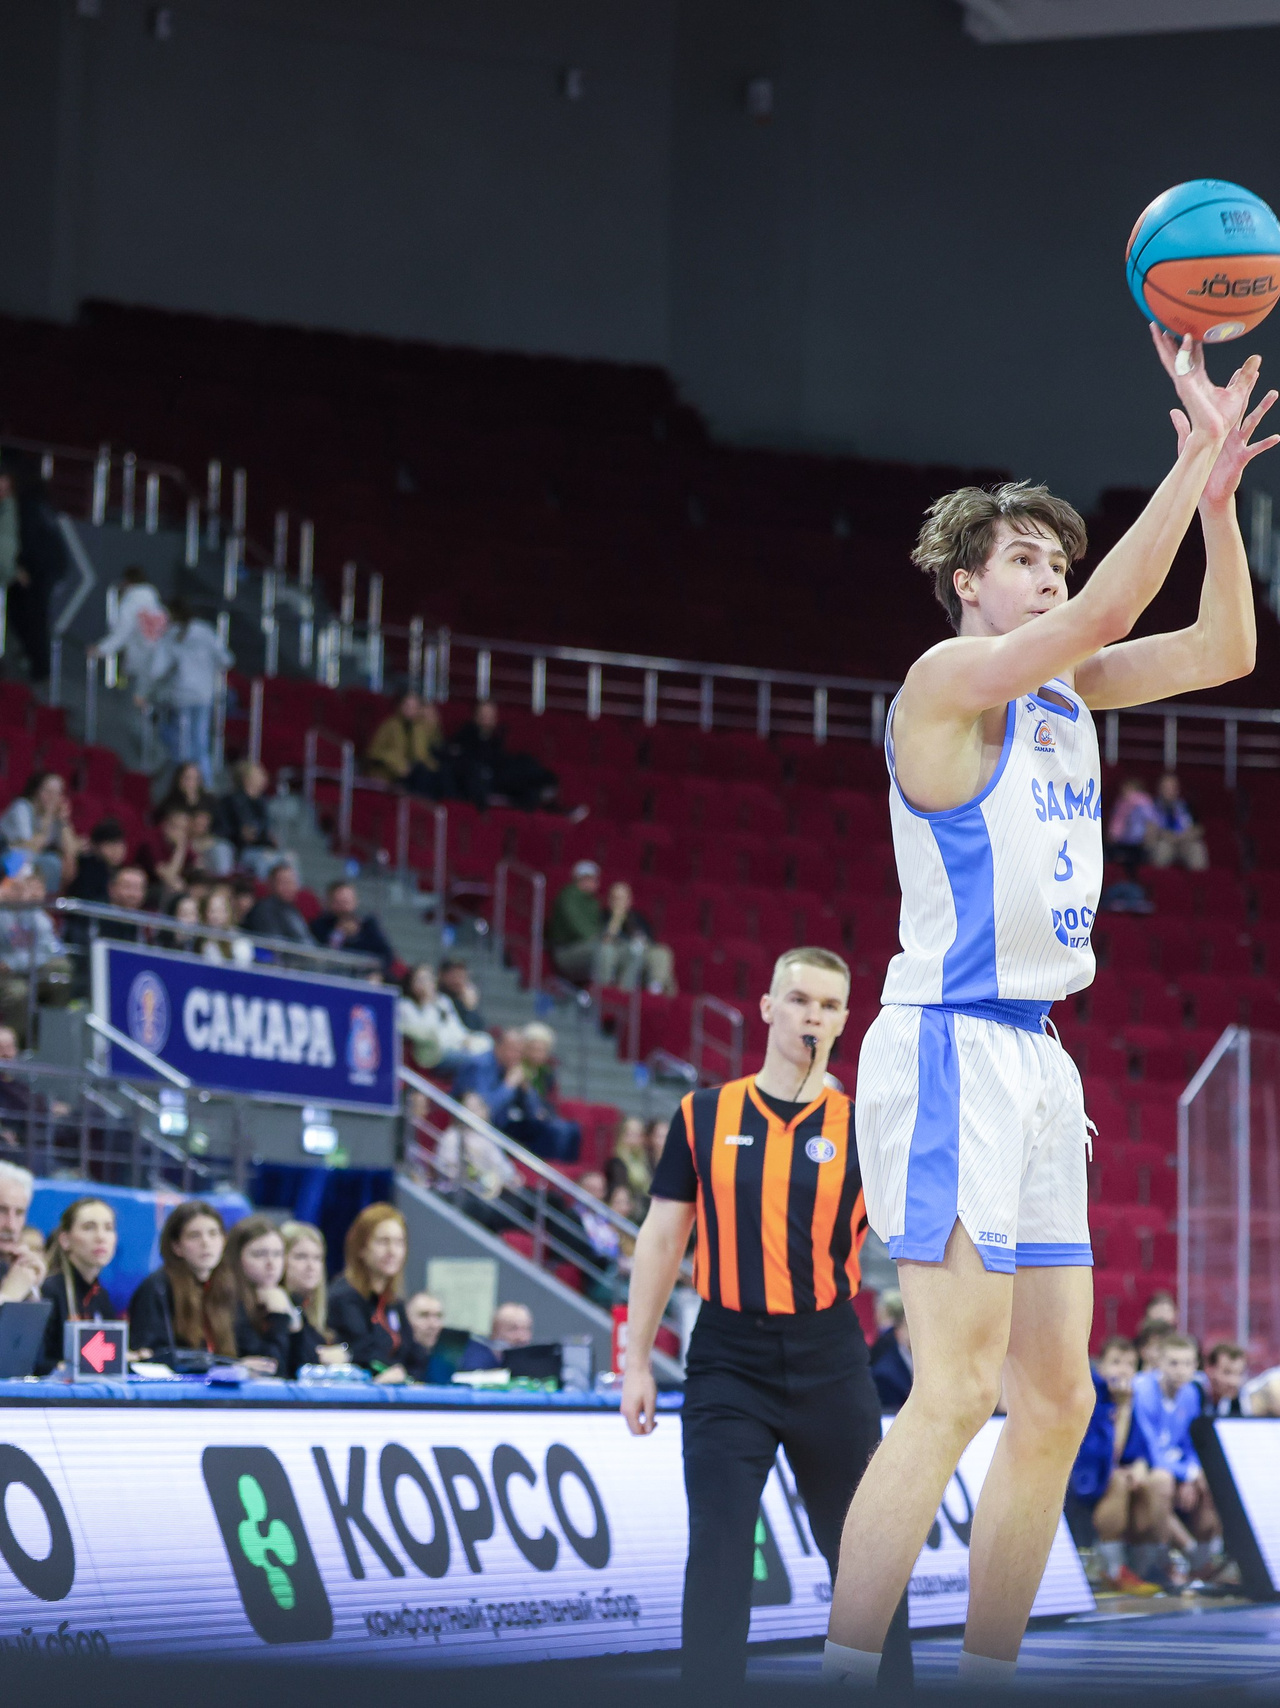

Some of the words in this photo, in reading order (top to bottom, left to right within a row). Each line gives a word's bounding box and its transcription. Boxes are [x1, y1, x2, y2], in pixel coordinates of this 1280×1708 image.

[1187, 274, 1280, 298] JÖGEL
[182, 986, 337, 1069] САМАРА
[978, 1230, 1008, 1245] ZEDO
[312, 1442, 612, 1580] КОРСО
